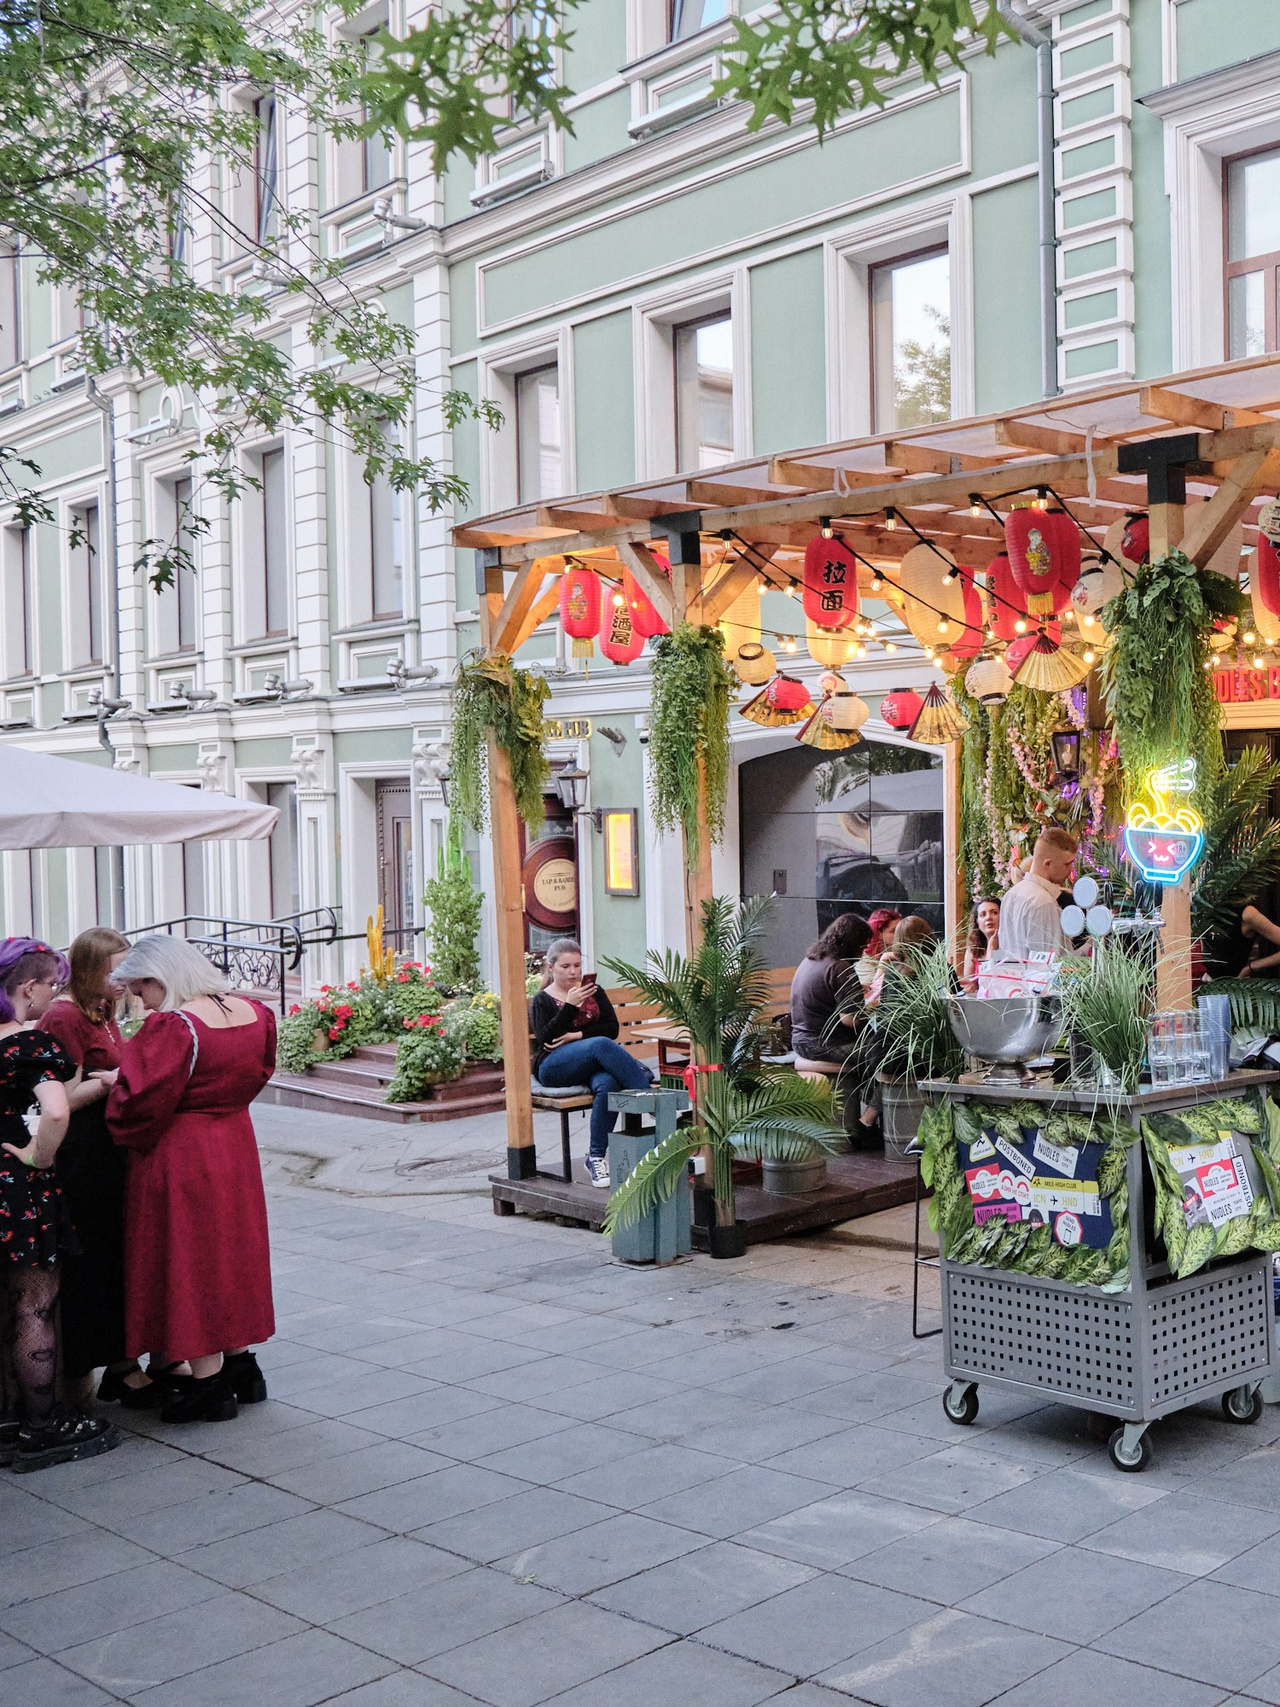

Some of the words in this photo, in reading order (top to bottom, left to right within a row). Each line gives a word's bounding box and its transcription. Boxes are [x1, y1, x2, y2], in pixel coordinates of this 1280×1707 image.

[822, 560, 847, 611] 拉面
[1212, 668, 1266, 702] DLES
[998, 1140, 1032, 1175] POSTBONED
[1235, 1161, 1253, 1211] OSTBONED
